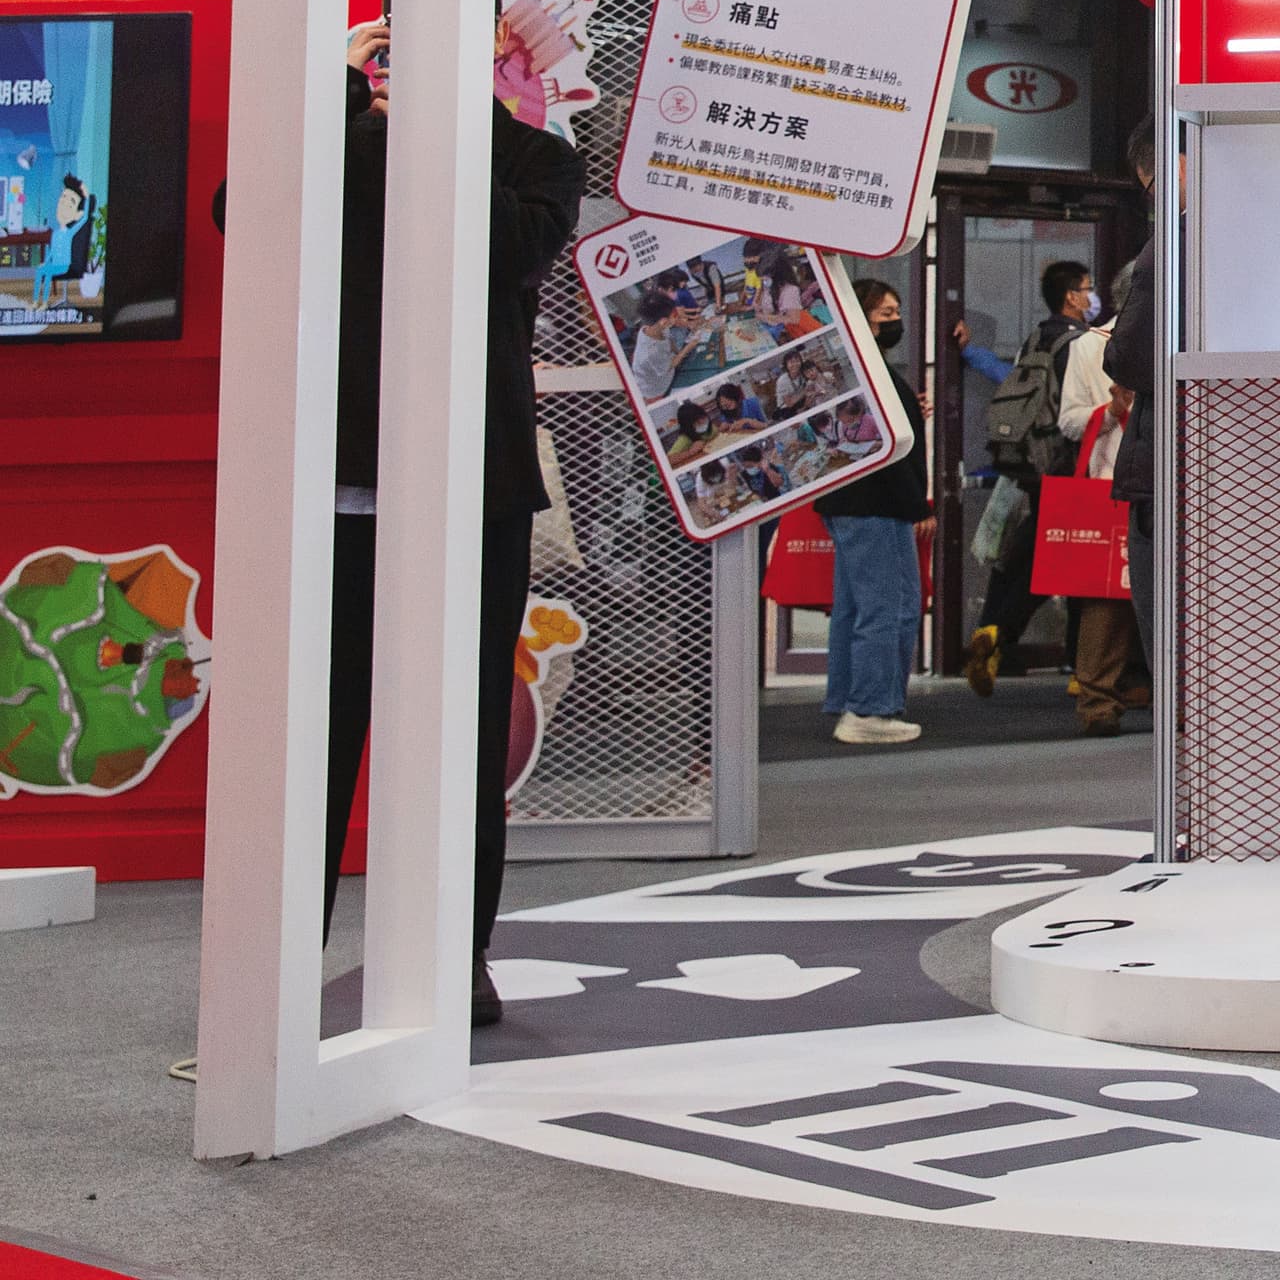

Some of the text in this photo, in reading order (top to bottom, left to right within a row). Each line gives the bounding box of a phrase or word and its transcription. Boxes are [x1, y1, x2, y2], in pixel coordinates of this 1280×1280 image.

[728, 1, 780, 31] 痛點
[705, 100, 809, 140] 解決方案
